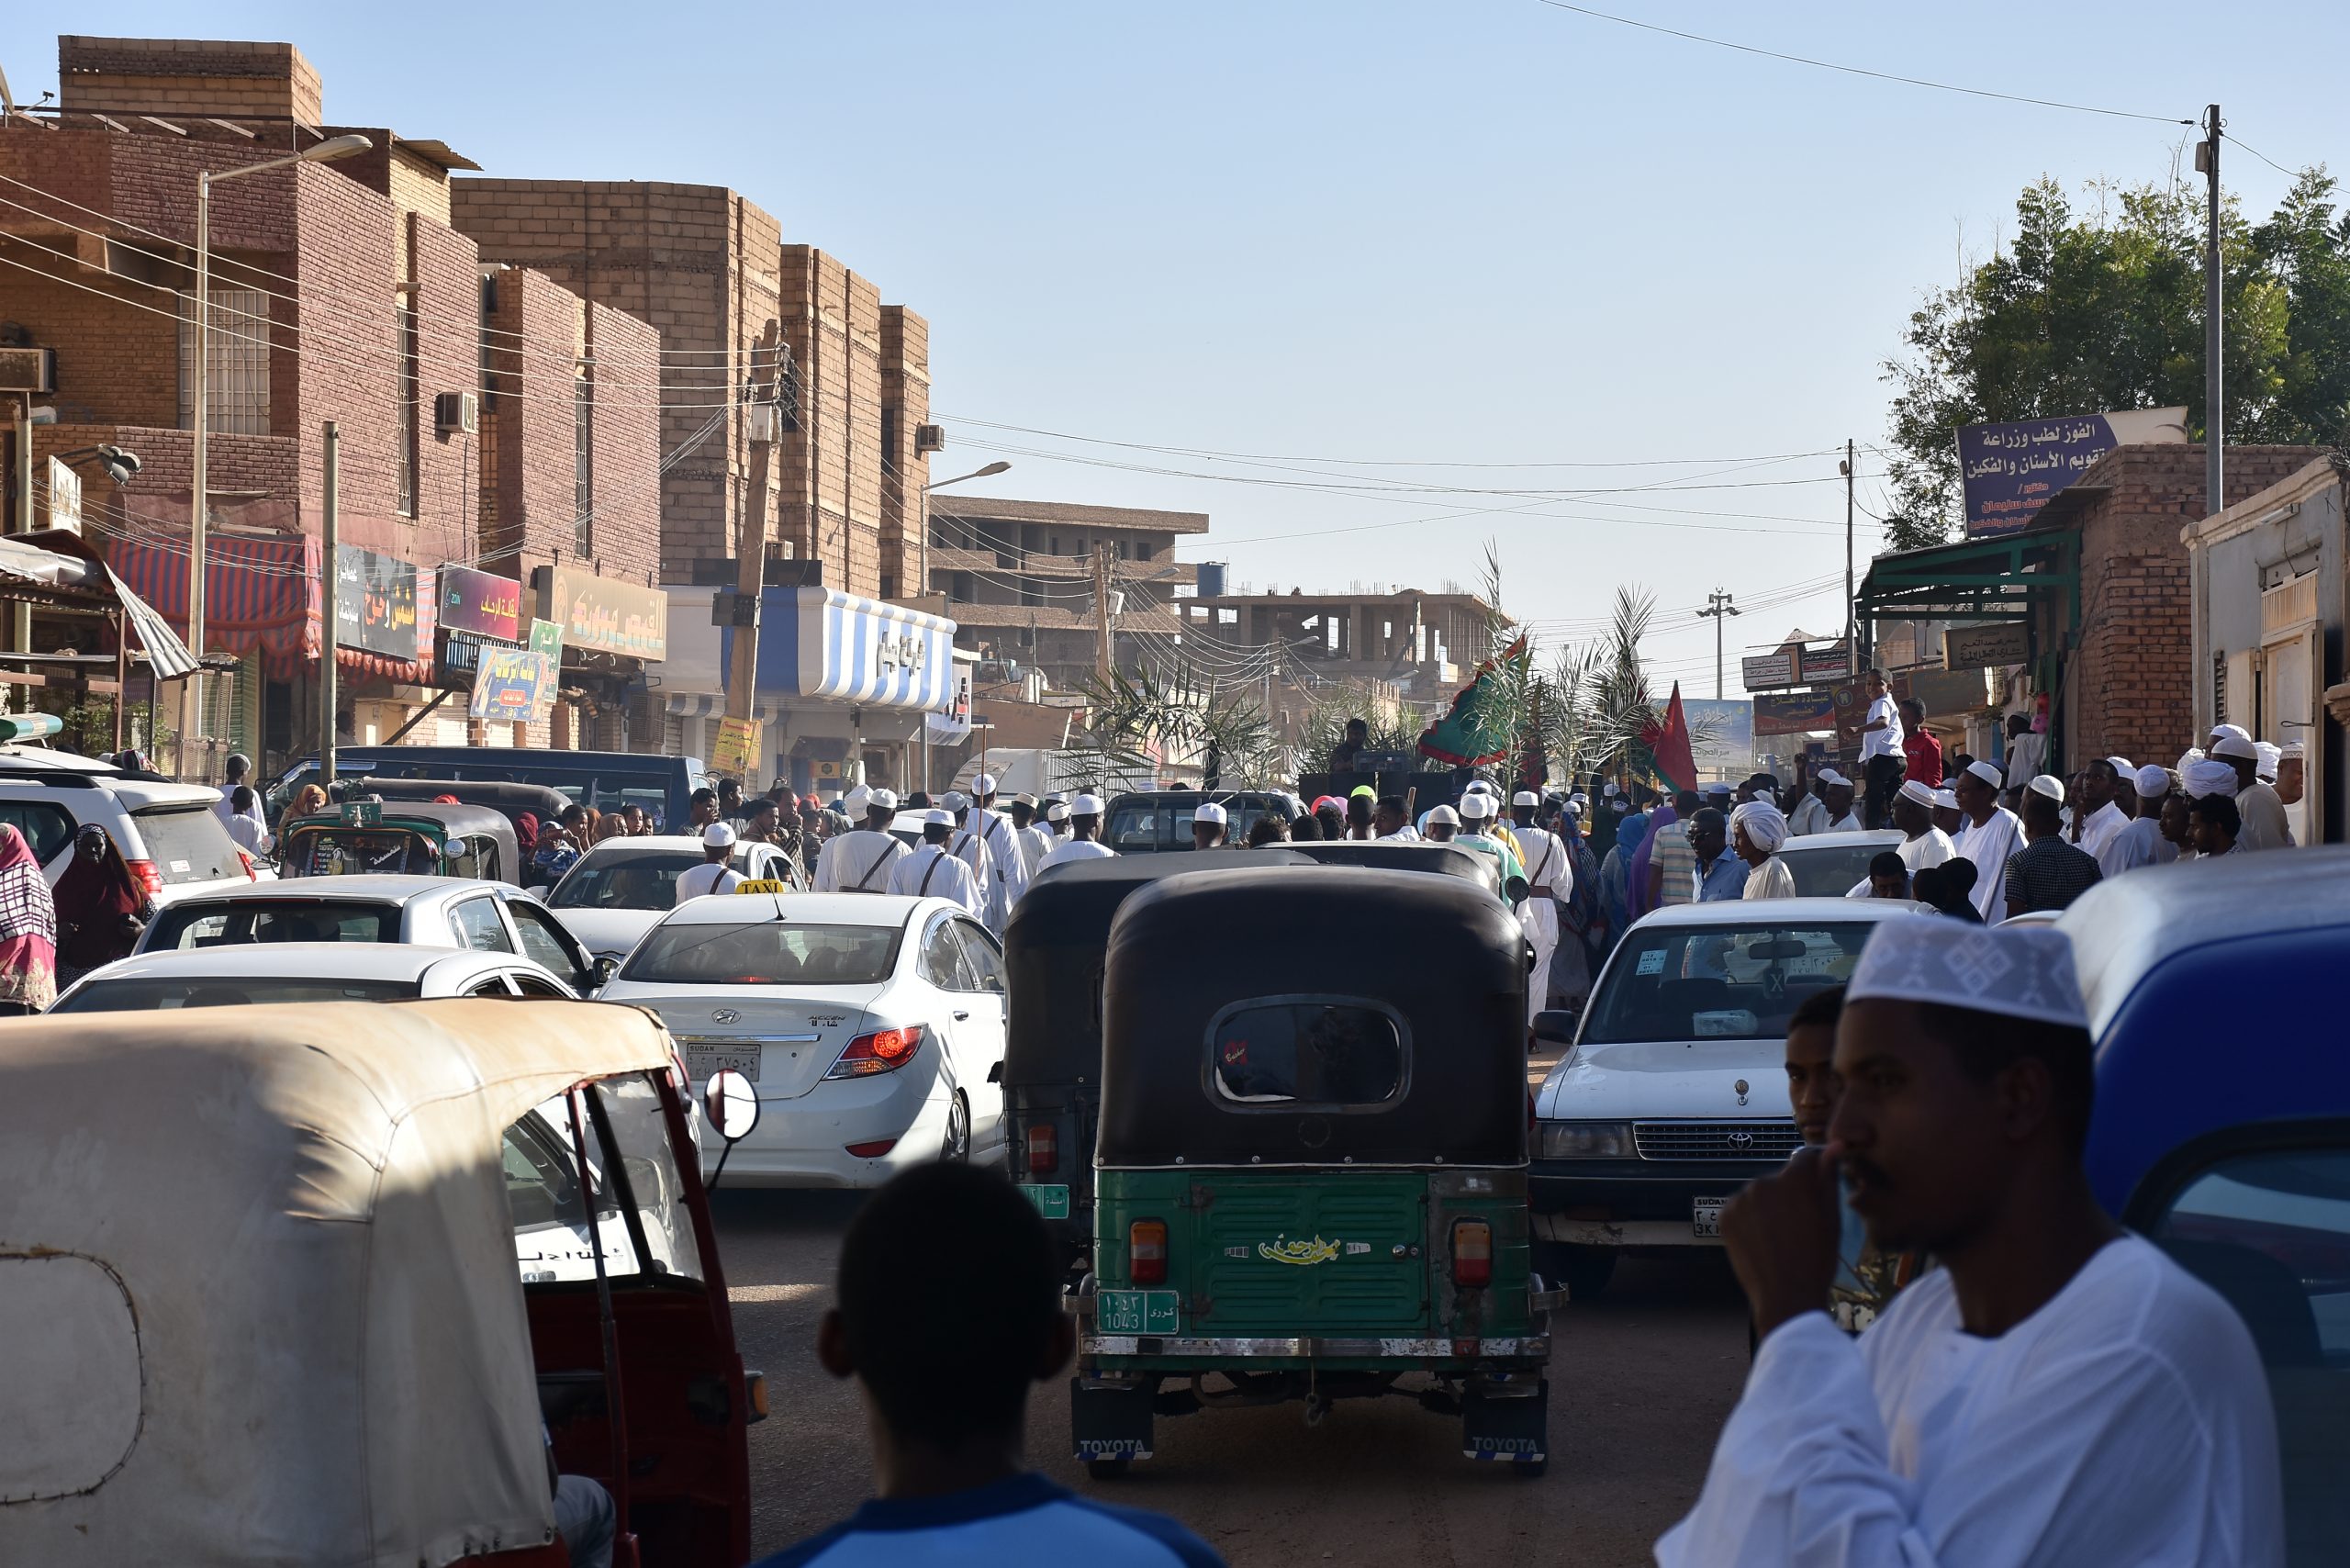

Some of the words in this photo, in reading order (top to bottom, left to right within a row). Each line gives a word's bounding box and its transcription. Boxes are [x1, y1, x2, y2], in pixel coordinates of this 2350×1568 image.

[1982, 429, 2028, 449] وزراعة
[2032, 426, 2060, 446] لطب
[2064, 422, 2095, 443] الفوز
[1967, 456, 2016, 479] والفكين
[2020, 451, 2064, 475] الأسنان
[2024, 482, 2049, 494] دكتور
[1982, 498, 2021, 513] سليمان
[391, 582, 415, 632] مشمش
[480, 594, 501, 622] الرحاب
[741, 882, 778, 894] TAXI
[1105, 1295, 1139, 1311] ١٠٤٣
[1105, 1314, 1139, 1329] 1043
[1080, 1439, 1146, 1453] TOYOTA
[1472, 1436, 1539, 1452] TOYOTA
